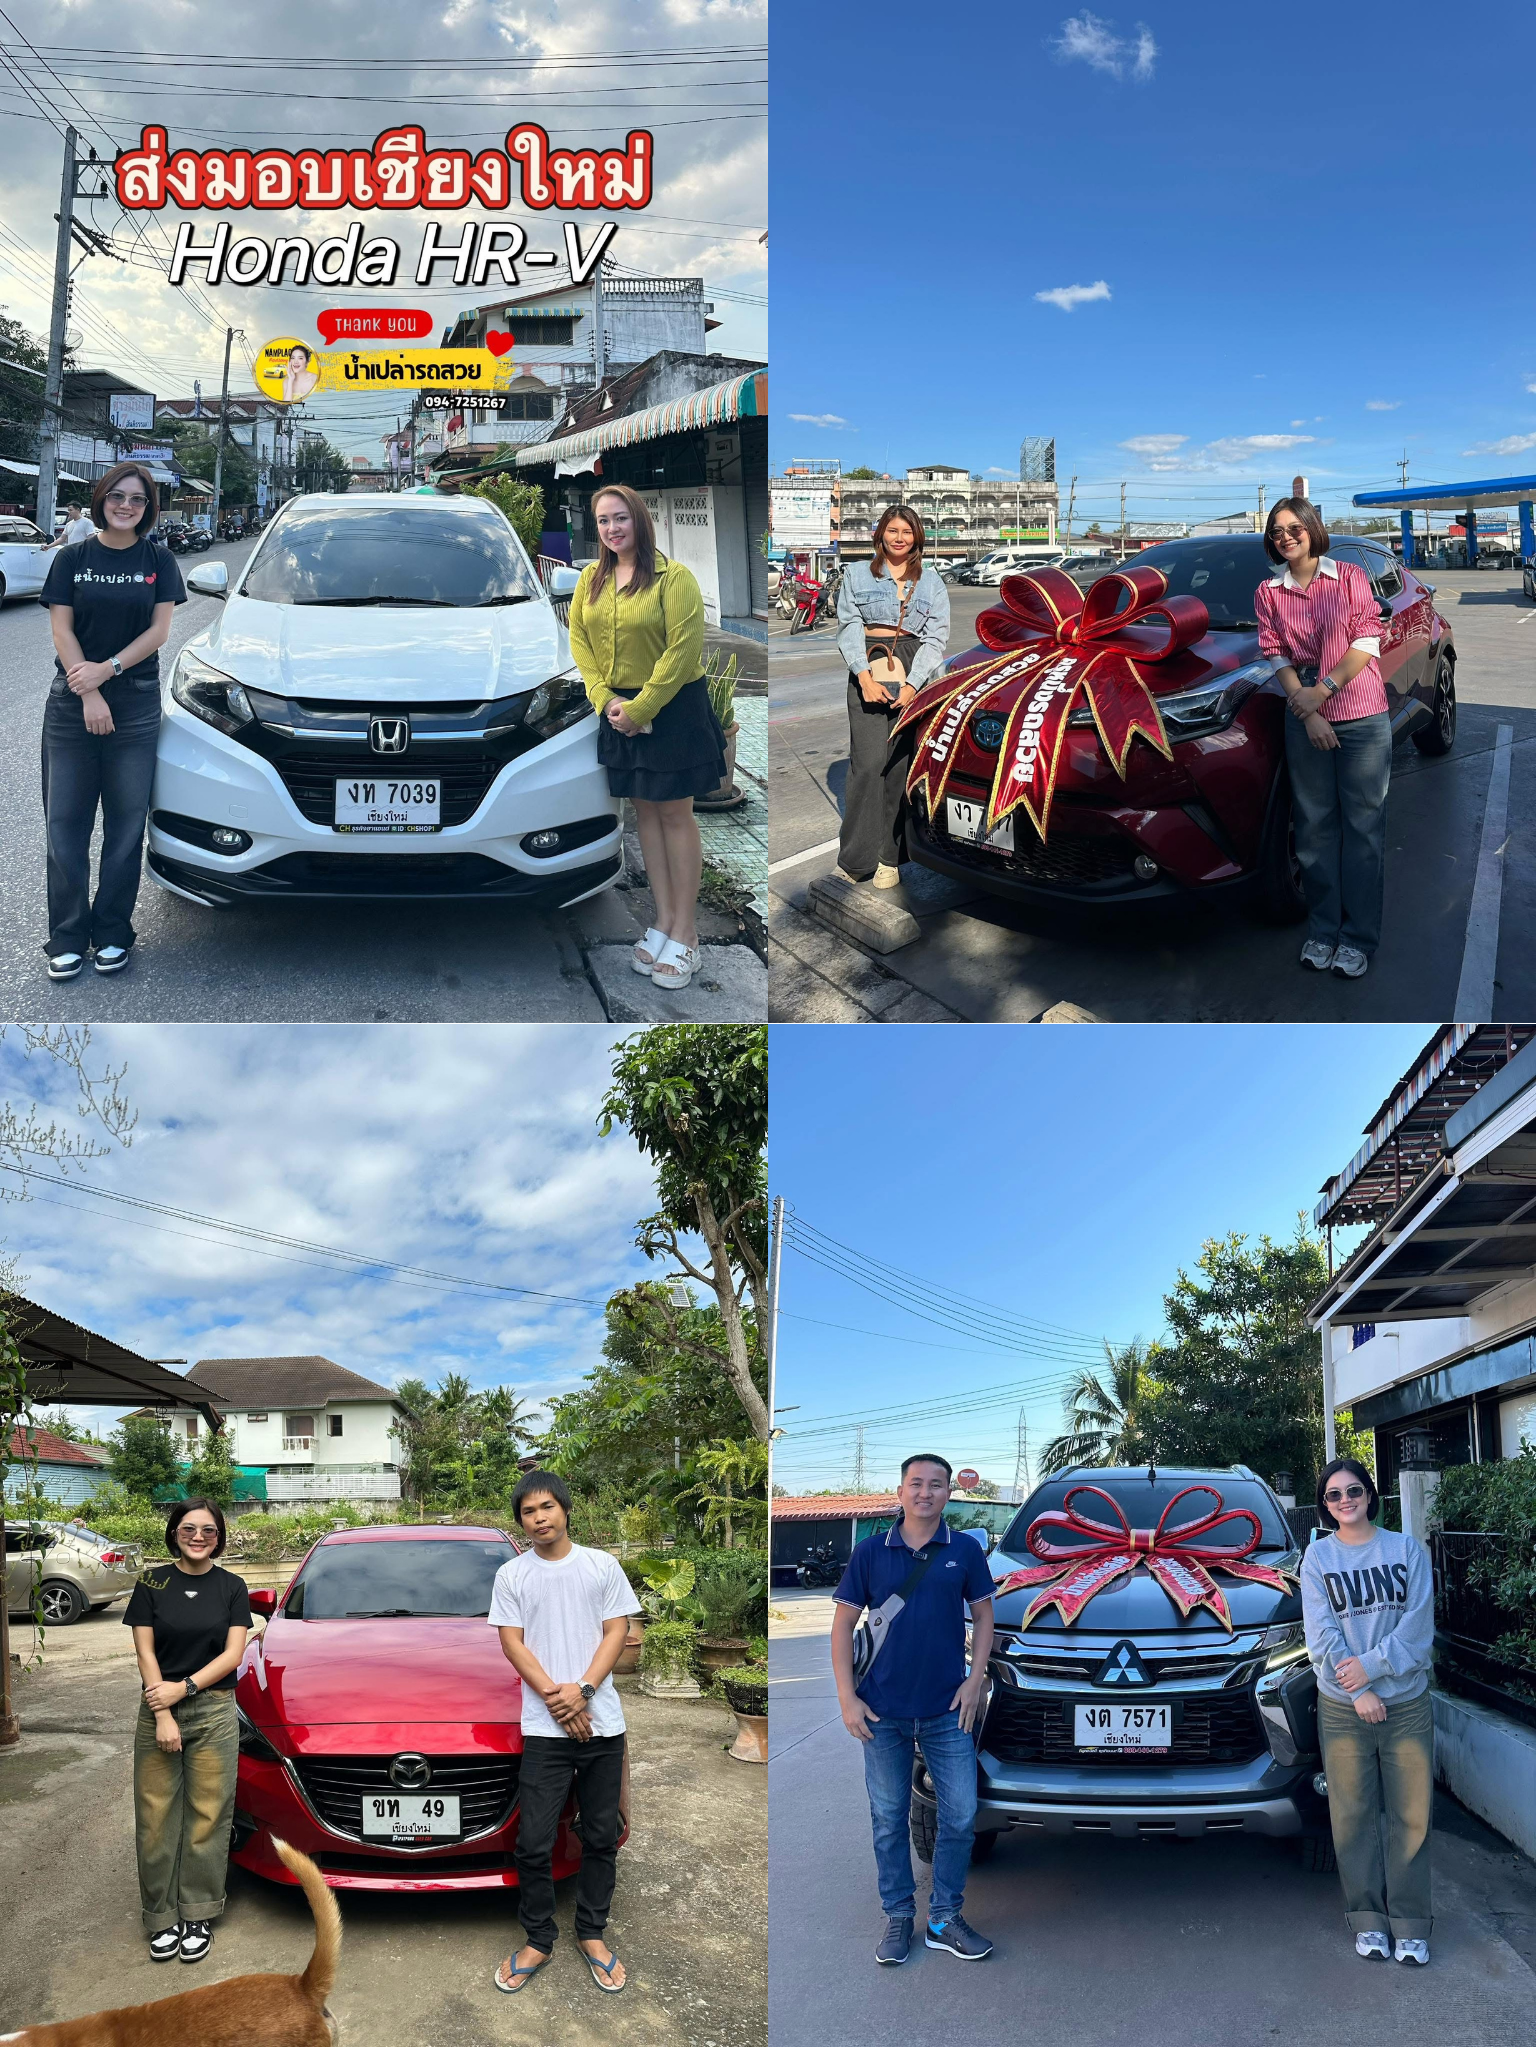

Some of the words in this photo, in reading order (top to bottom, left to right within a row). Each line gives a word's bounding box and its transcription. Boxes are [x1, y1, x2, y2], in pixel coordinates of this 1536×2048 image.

[74, 568, 132, 583] #น้ำเปล่า
[925, 653, 1041, 762] น้ำเปล่ารถสวย
[348, 783, 376, 804] งท
[387, 783, 437, 804] 7039
[368, 810, 408, 822] เชียงใหม่
[1323, 1563, 1408, 1613] DVJNS
[1085, 1708, 1111, 1728] งต
[1122, 1708, 1166, 1728] 7571
[1103, 1733, 1142, 1744] เชียงใหม่
[372, 1798, 400, 1818] ขท
[421, 1798, 445, 1818] 49
[392, 1821, 431, 1833] เชียงใหม่
